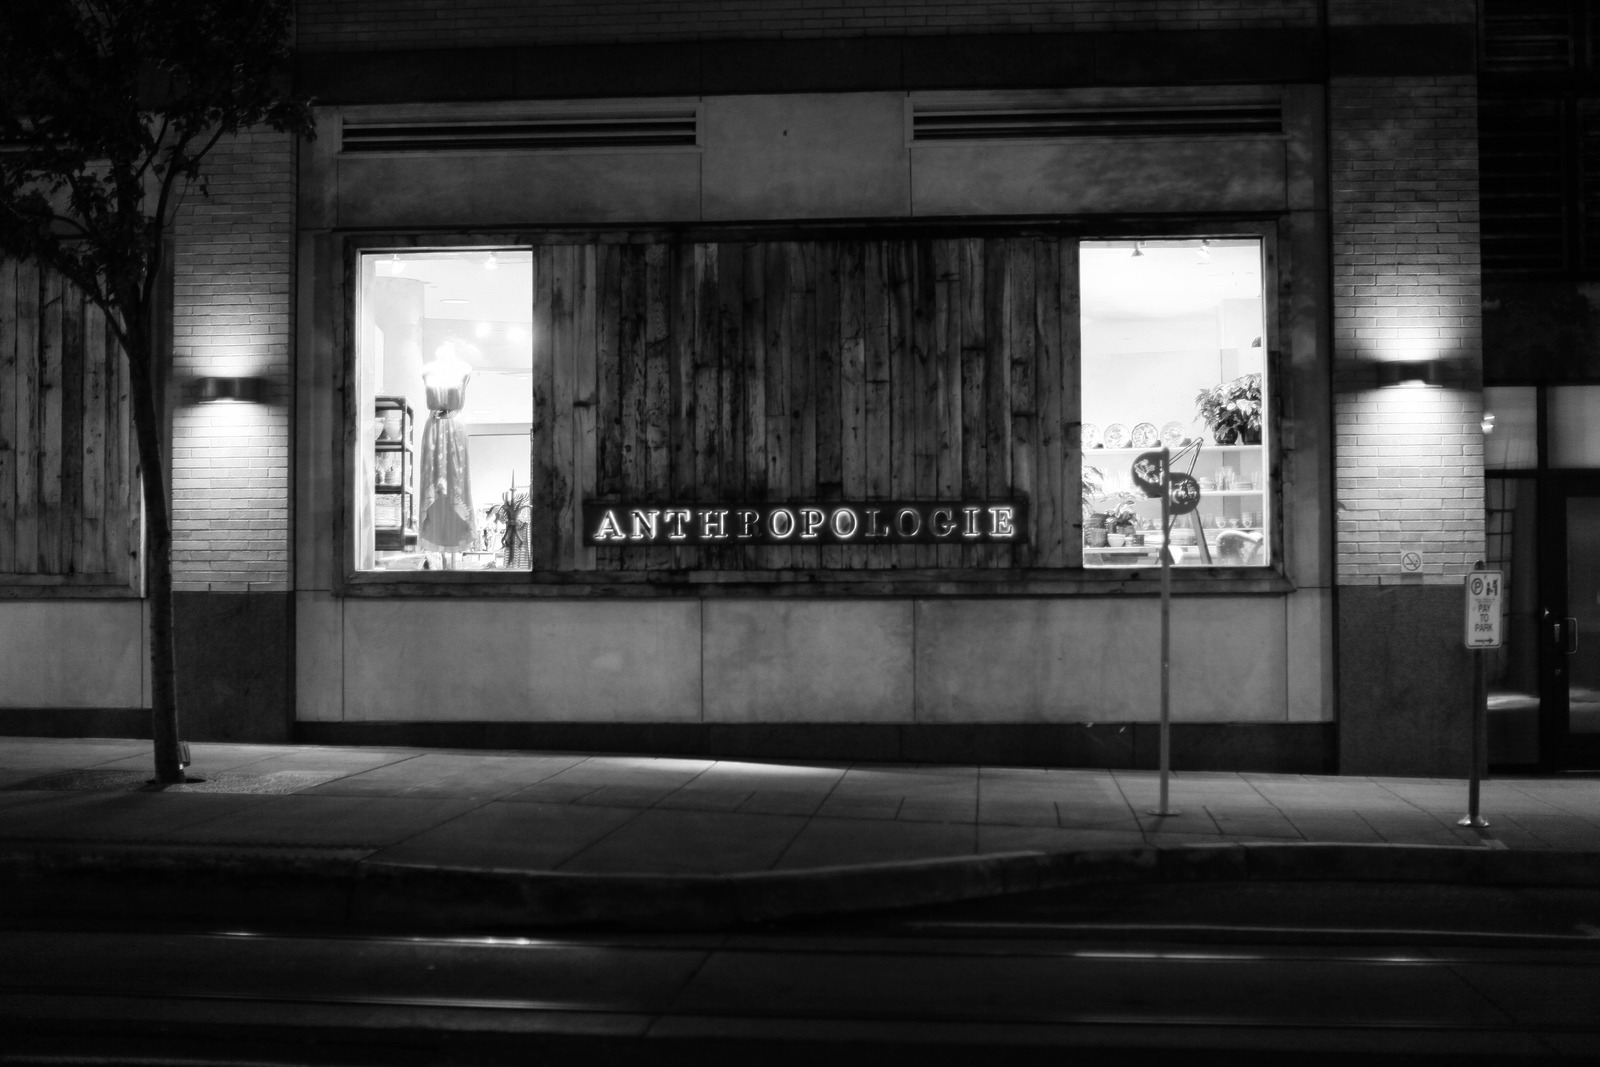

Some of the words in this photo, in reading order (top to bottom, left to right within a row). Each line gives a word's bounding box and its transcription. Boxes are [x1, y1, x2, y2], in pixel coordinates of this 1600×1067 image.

[593, 507, 1015, 541] ANTHROPOLOGIE
[1478, 604, 1492, 613] PAY
[1479, 613, 1490, 623] TO
[1474, 623, 1494, 632] PARK
